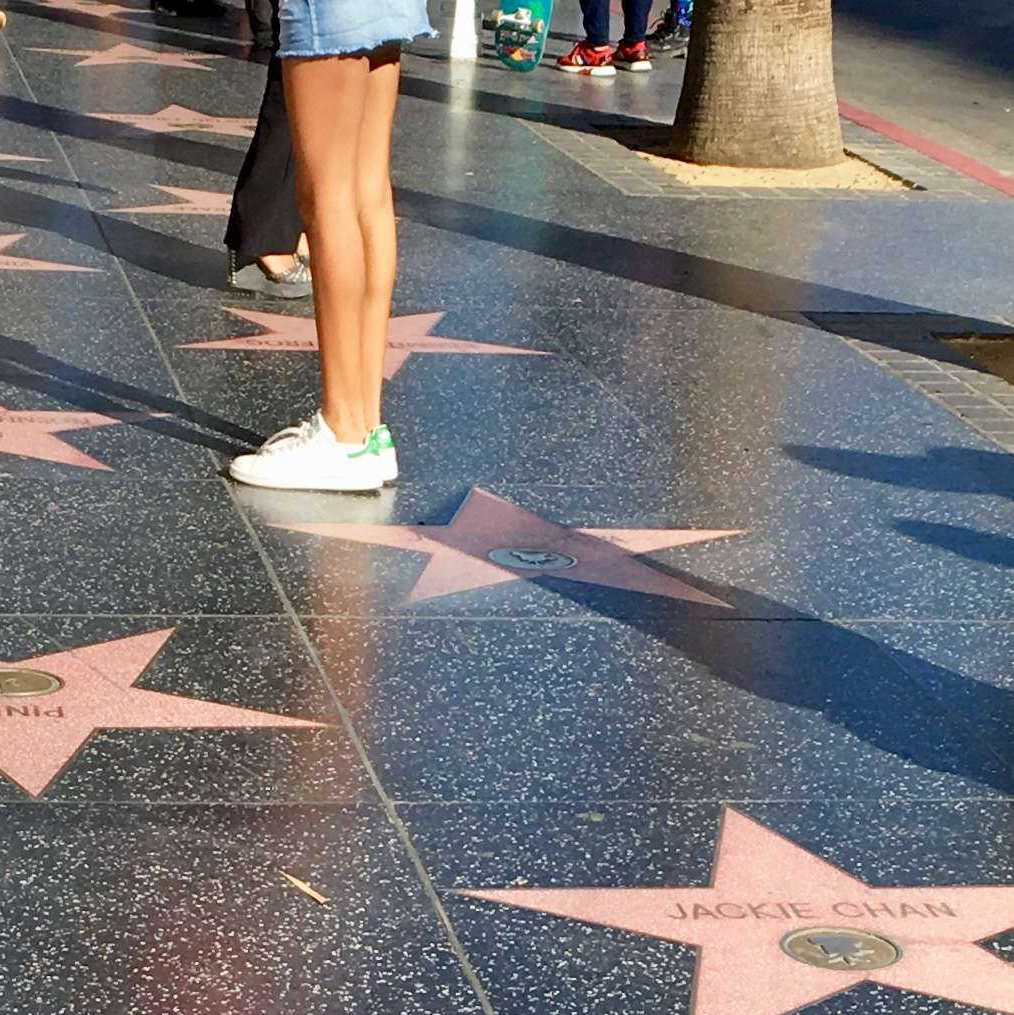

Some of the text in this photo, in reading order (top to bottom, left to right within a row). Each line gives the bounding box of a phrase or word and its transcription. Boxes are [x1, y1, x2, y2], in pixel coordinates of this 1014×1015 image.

[246, 339, 314, 347] FROG
[668, 902, 957, 920] JACKIE CHAN
